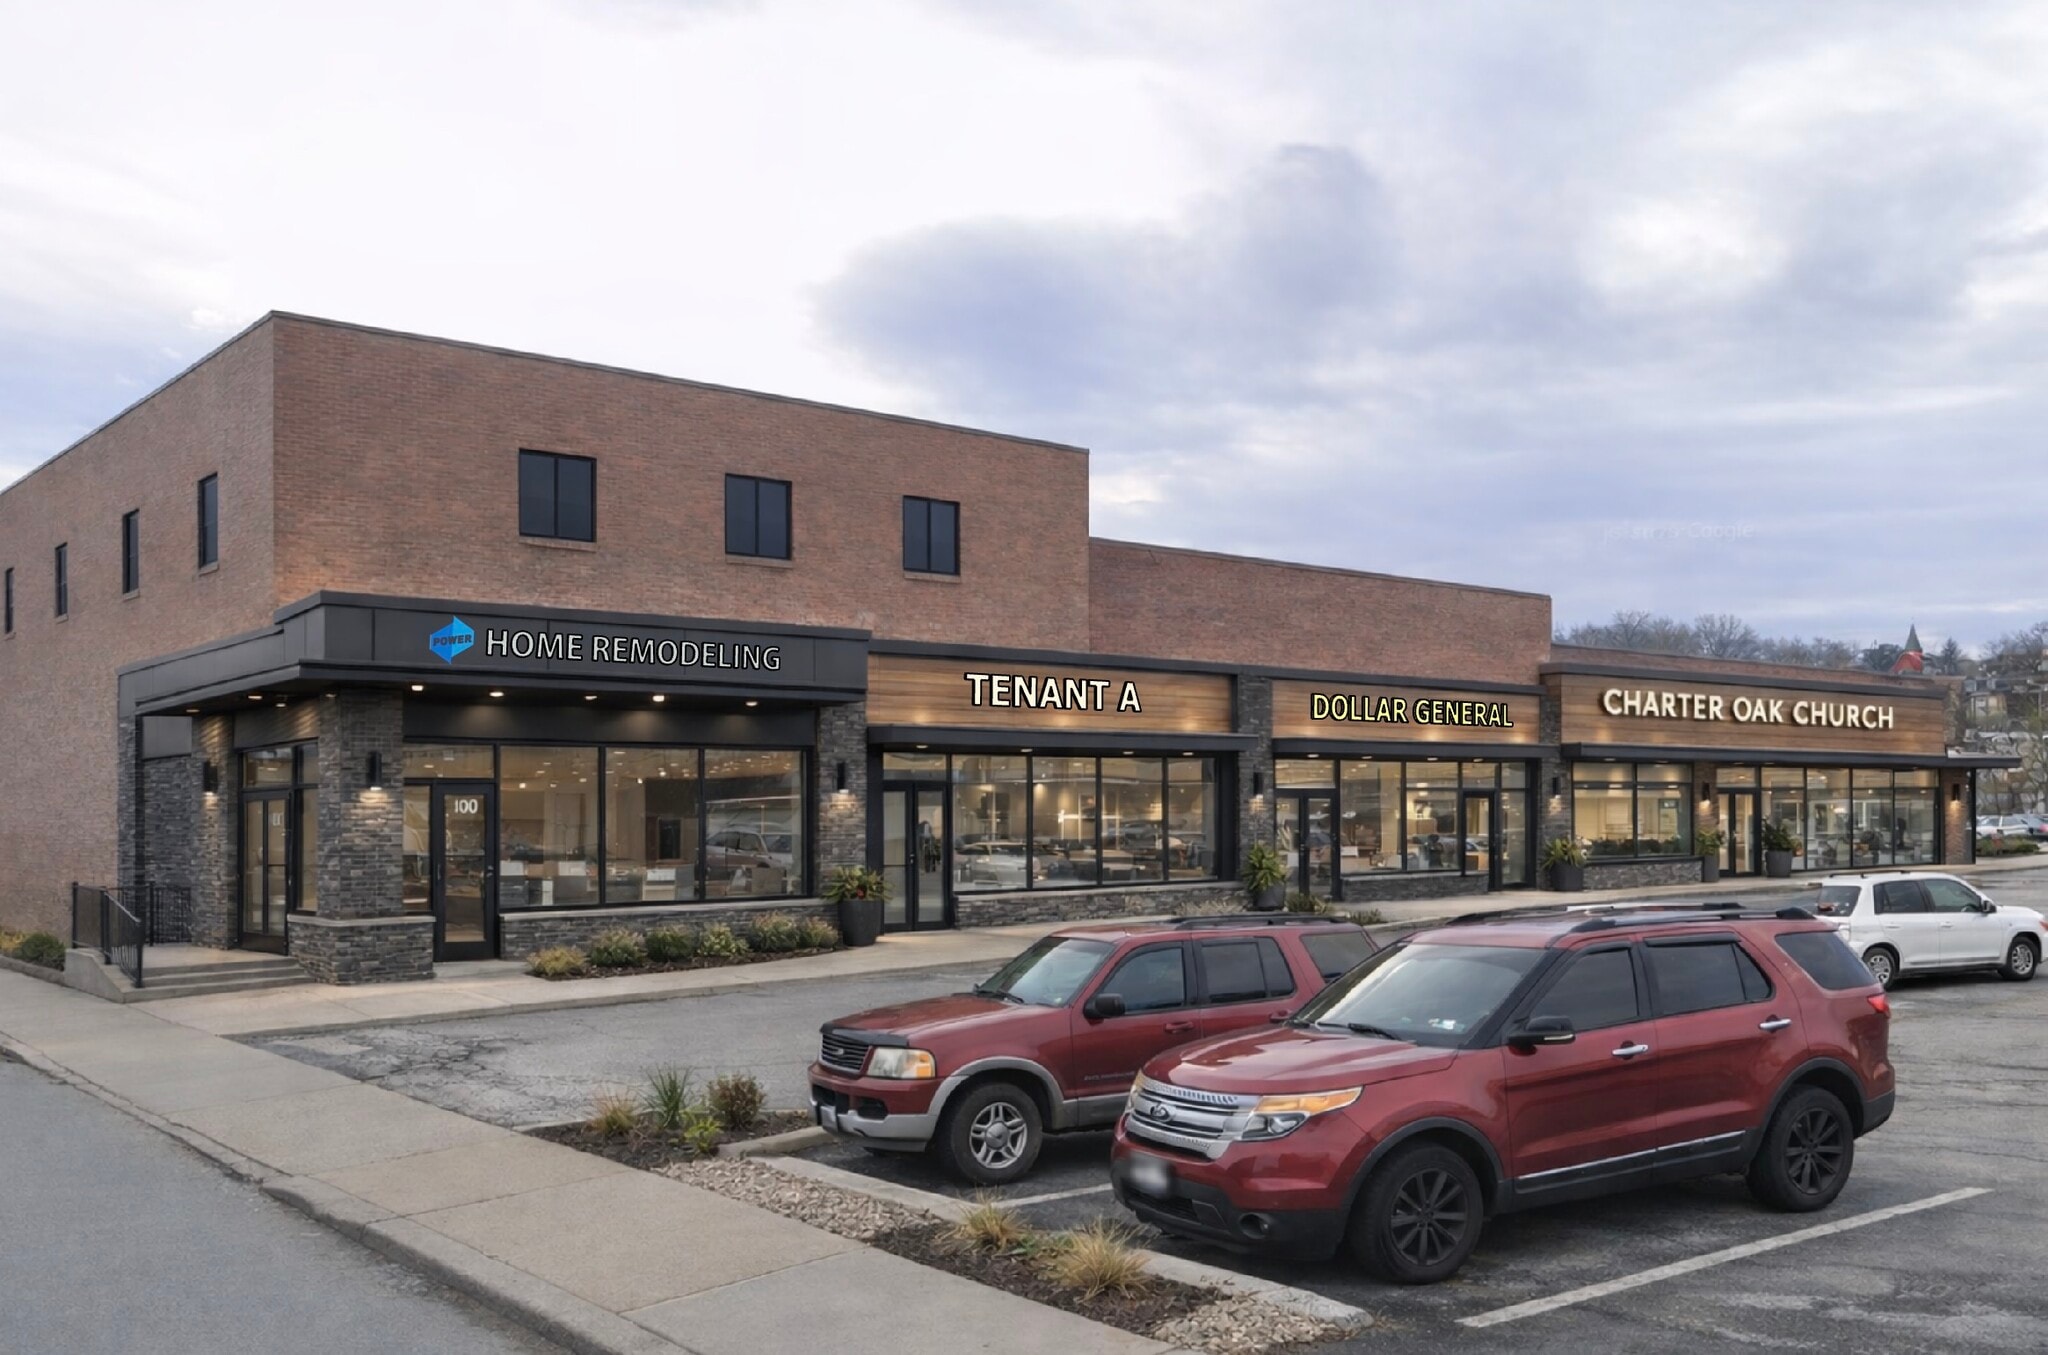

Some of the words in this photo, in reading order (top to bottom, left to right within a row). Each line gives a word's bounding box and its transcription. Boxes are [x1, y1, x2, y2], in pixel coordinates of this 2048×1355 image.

[433, 633, 473, 647] POWER
[485, 628, 583, 660] HOME
[590, 635, 782, 671] REMODELING
[964, 672, 1110, 710] TENANT
[1116, 681, 1142, 712] A
[1311, 693, 1409, 723] DOLLAR
[1413, 698, 1514, 728] GENERAL
[1603, 688, 1725, 721] CHARTER
[1731, 696, 1784, 724] OAK
[1792, 700, 1894, 729] CHURCH
[454, 798, 479, 814] 100
